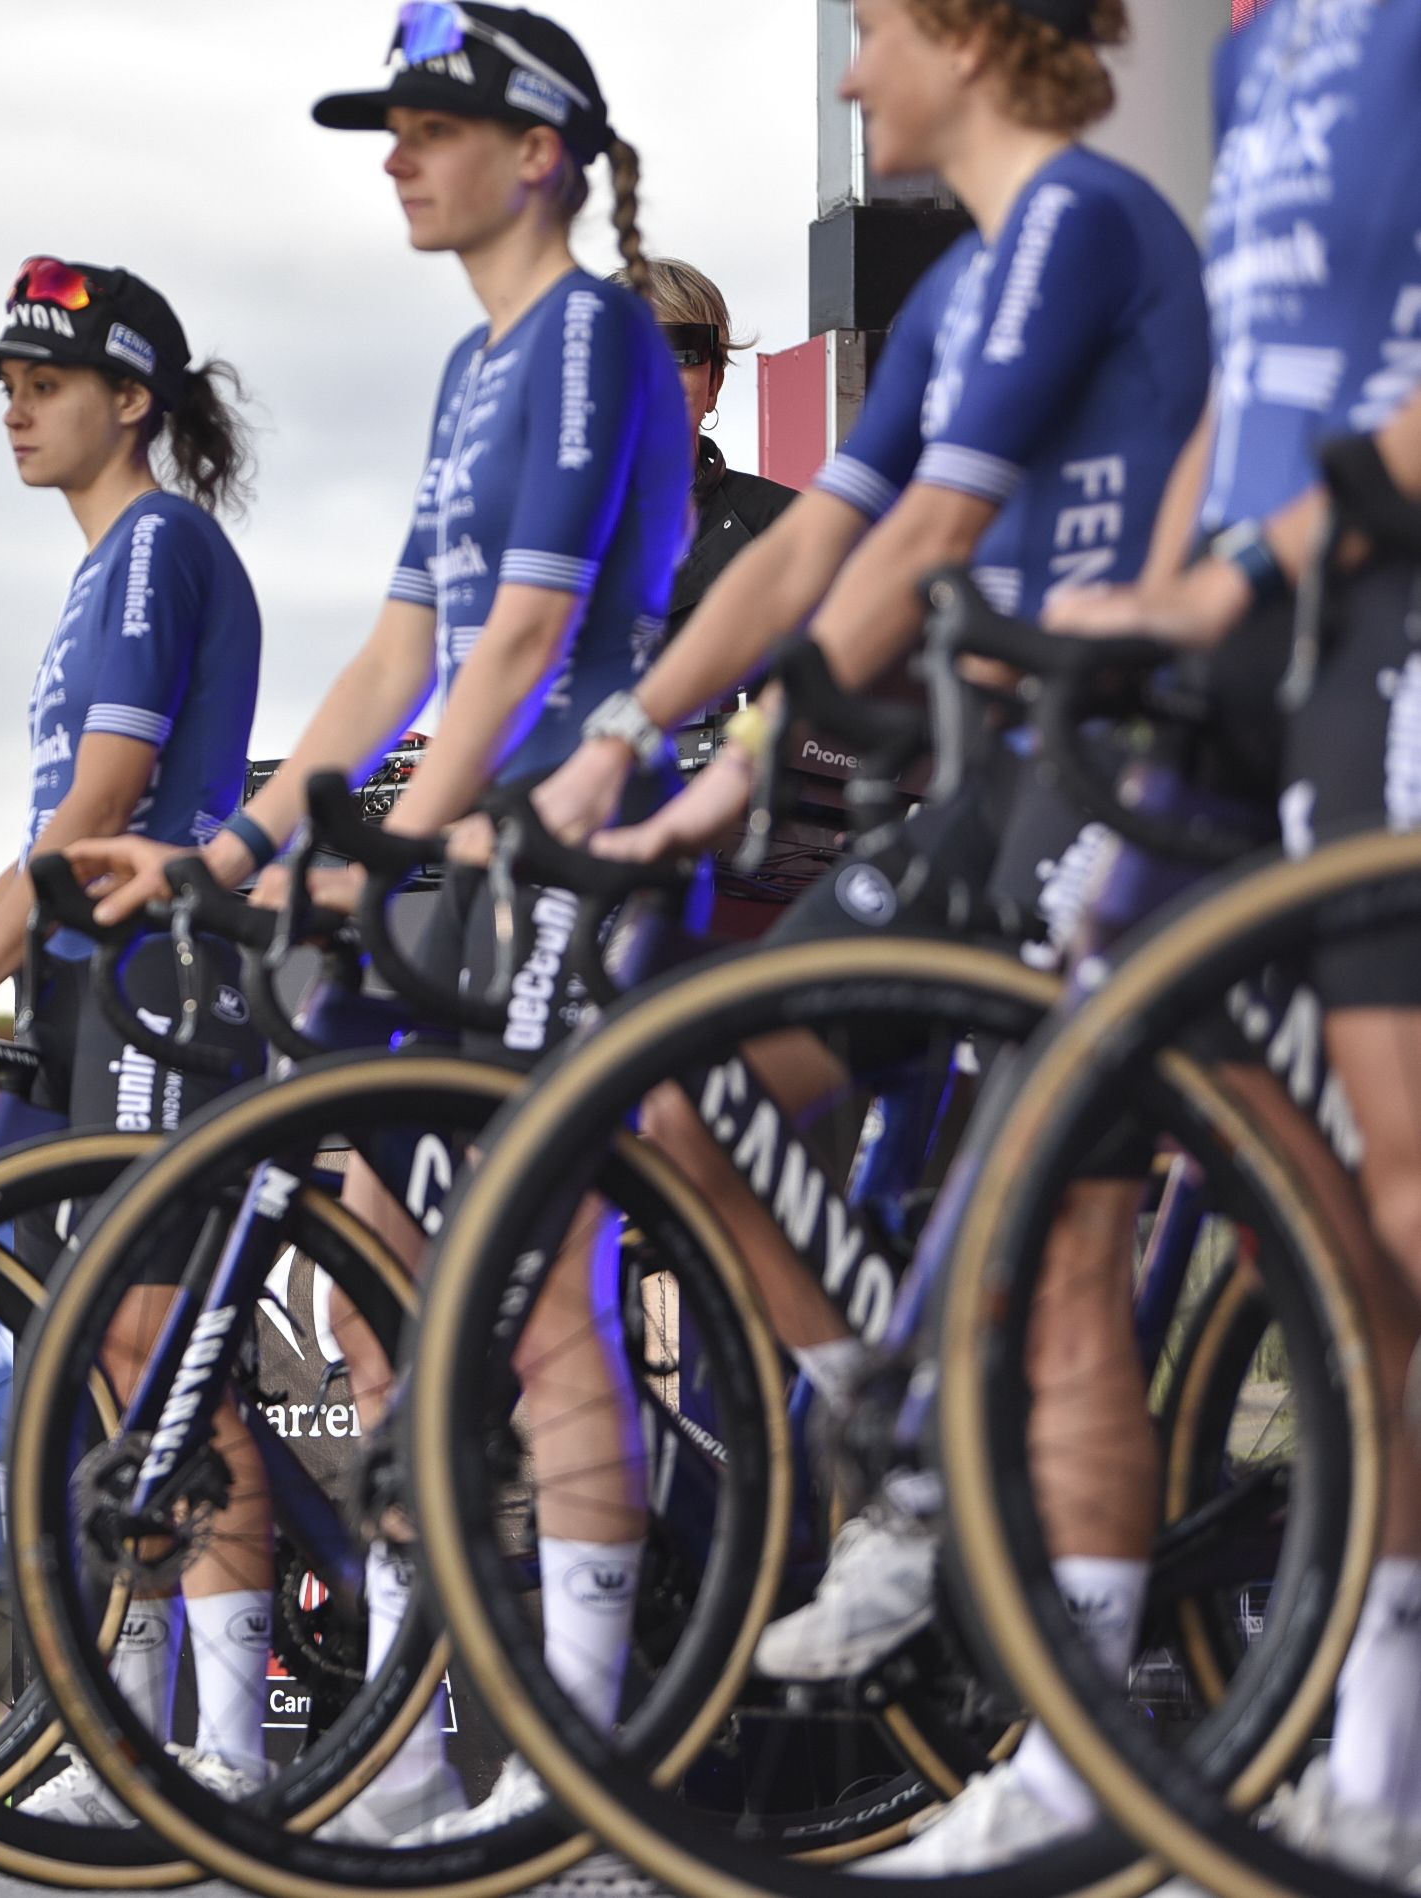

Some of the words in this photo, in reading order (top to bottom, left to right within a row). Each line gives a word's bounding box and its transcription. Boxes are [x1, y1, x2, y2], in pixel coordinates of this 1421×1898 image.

[122, 513, 166, 639] deceuninck
[802, 740, 865, 769] Pione
[699, 1057, 896, 1346] CANYO
[139, 1304, 238, 1480] CANYON
